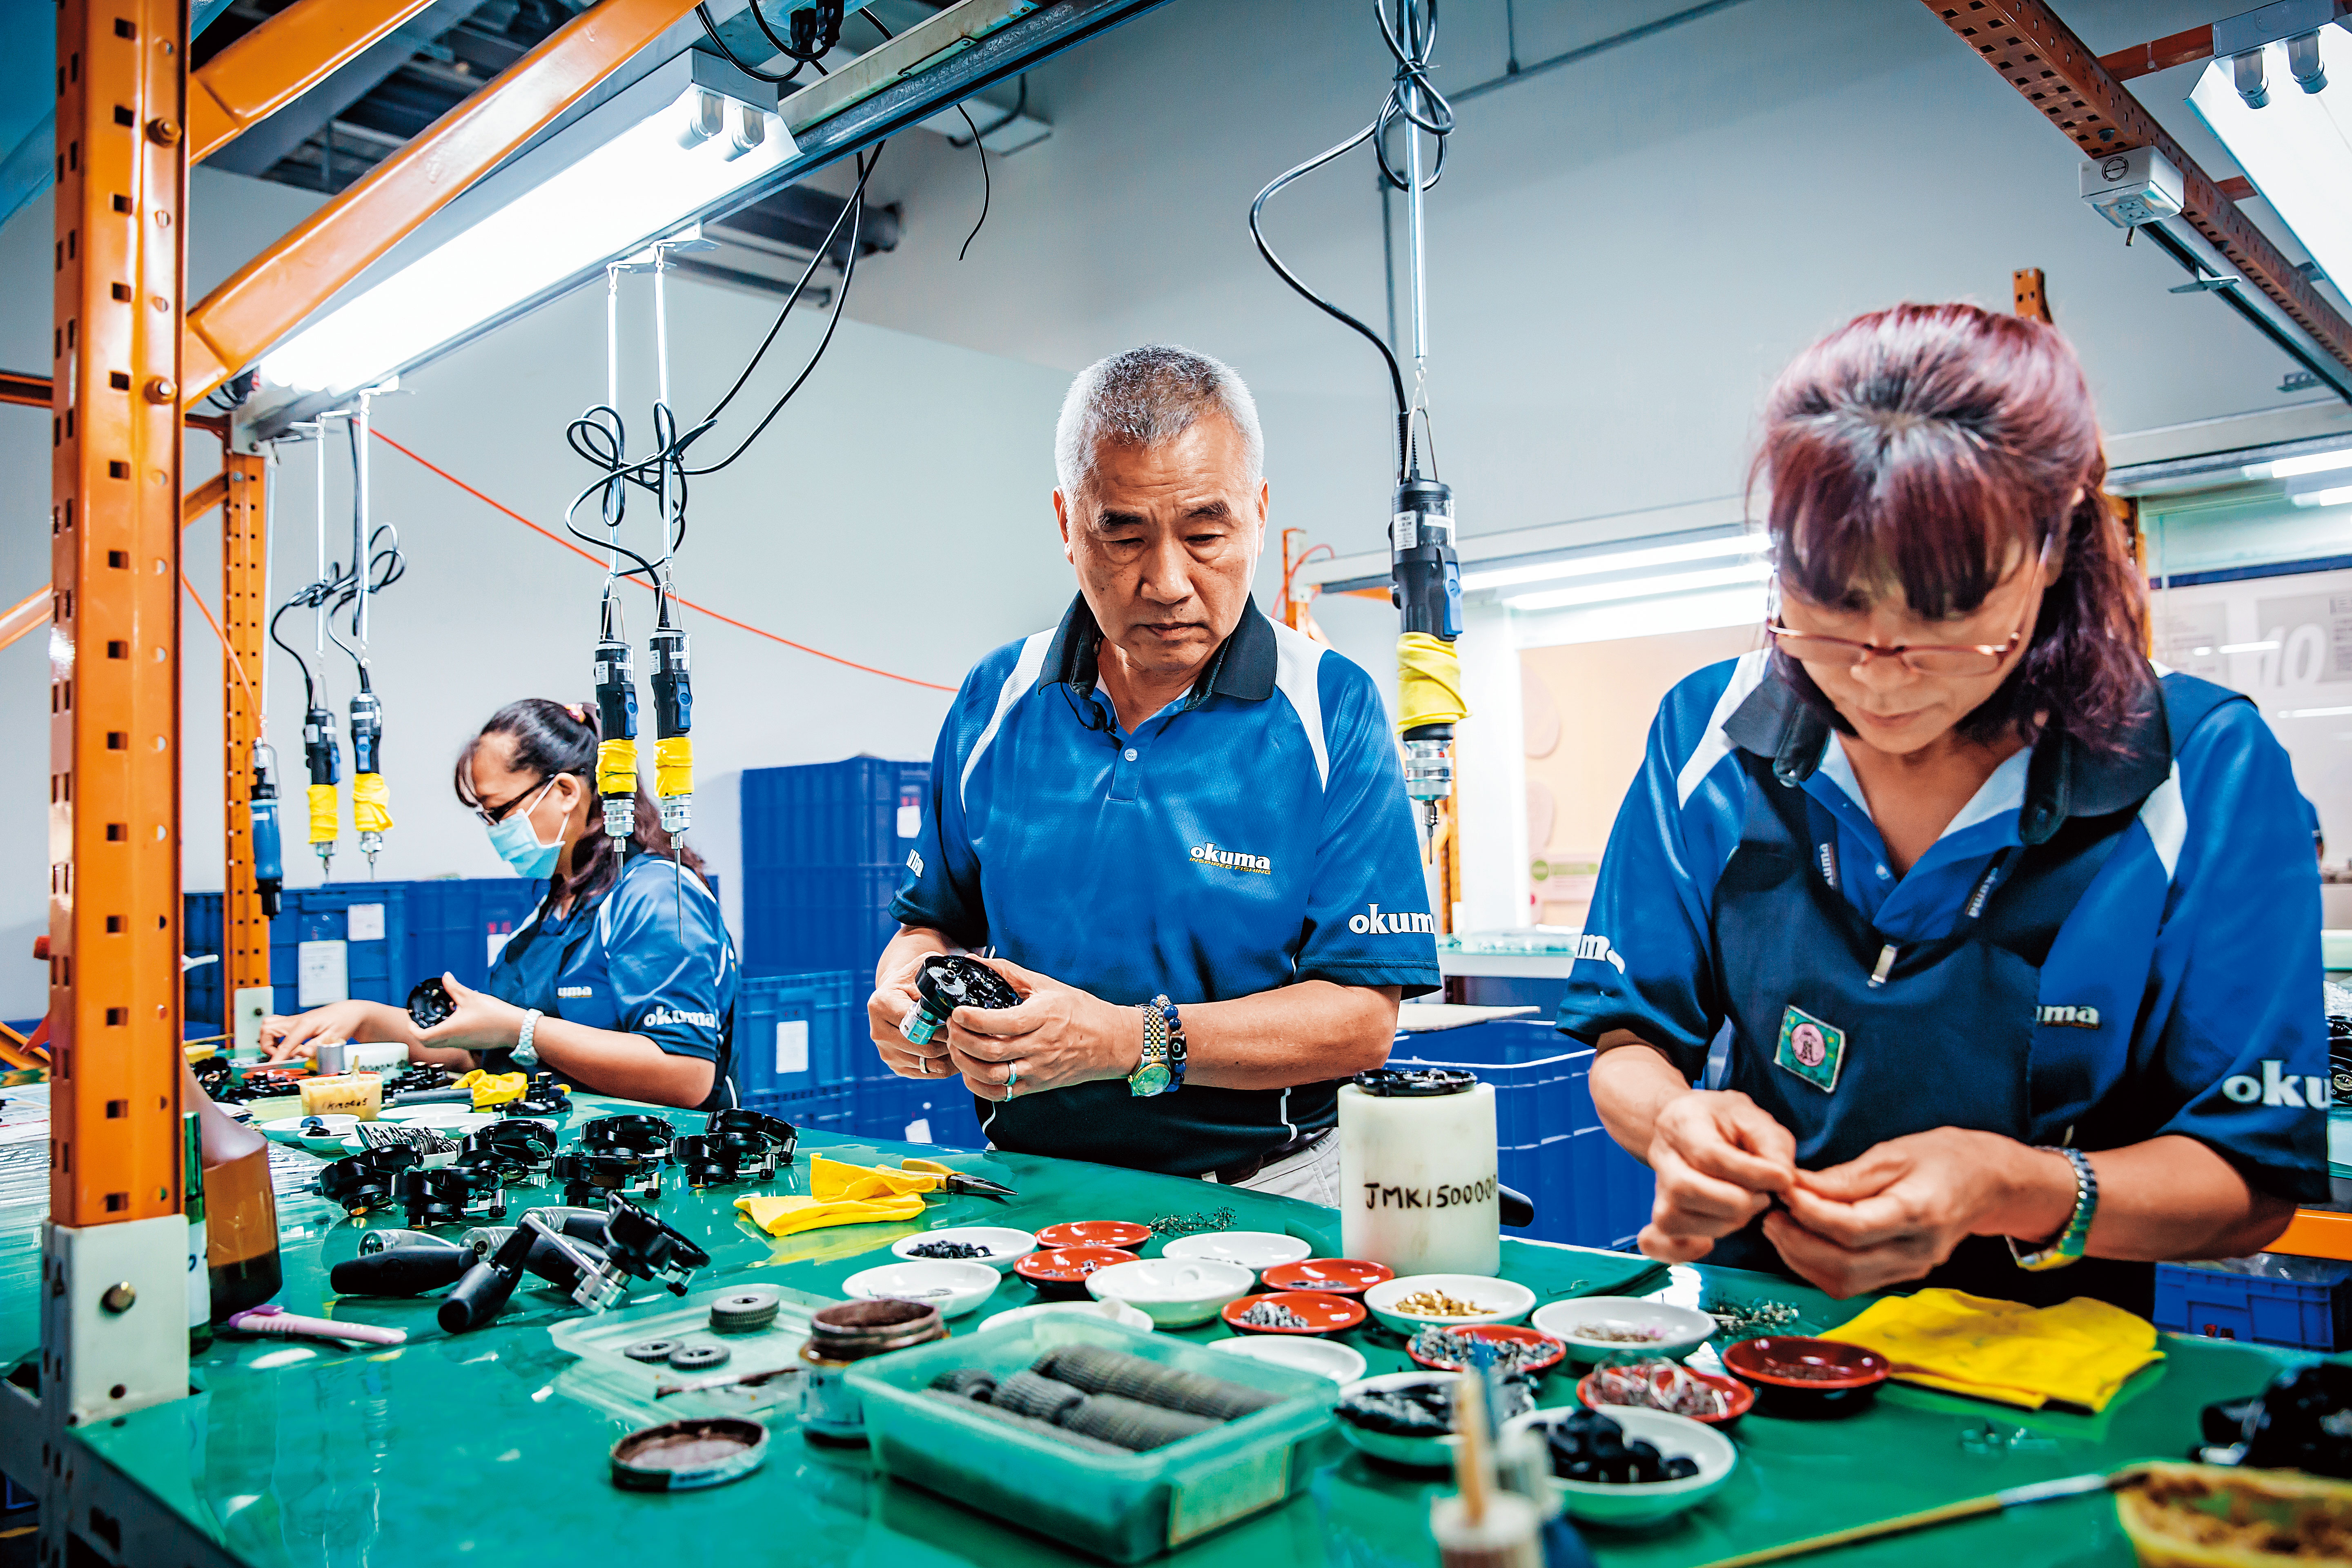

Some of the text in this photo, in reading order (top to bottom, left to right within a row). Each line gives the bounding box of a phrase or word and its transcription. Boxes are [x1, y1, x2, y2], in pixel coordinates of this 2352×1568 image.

[1189, 857, 1272, 875] INSPIRED FISHING
[1190, 842, 1271, 871] okuma
[644, 1005, 716, 1028] okuma
